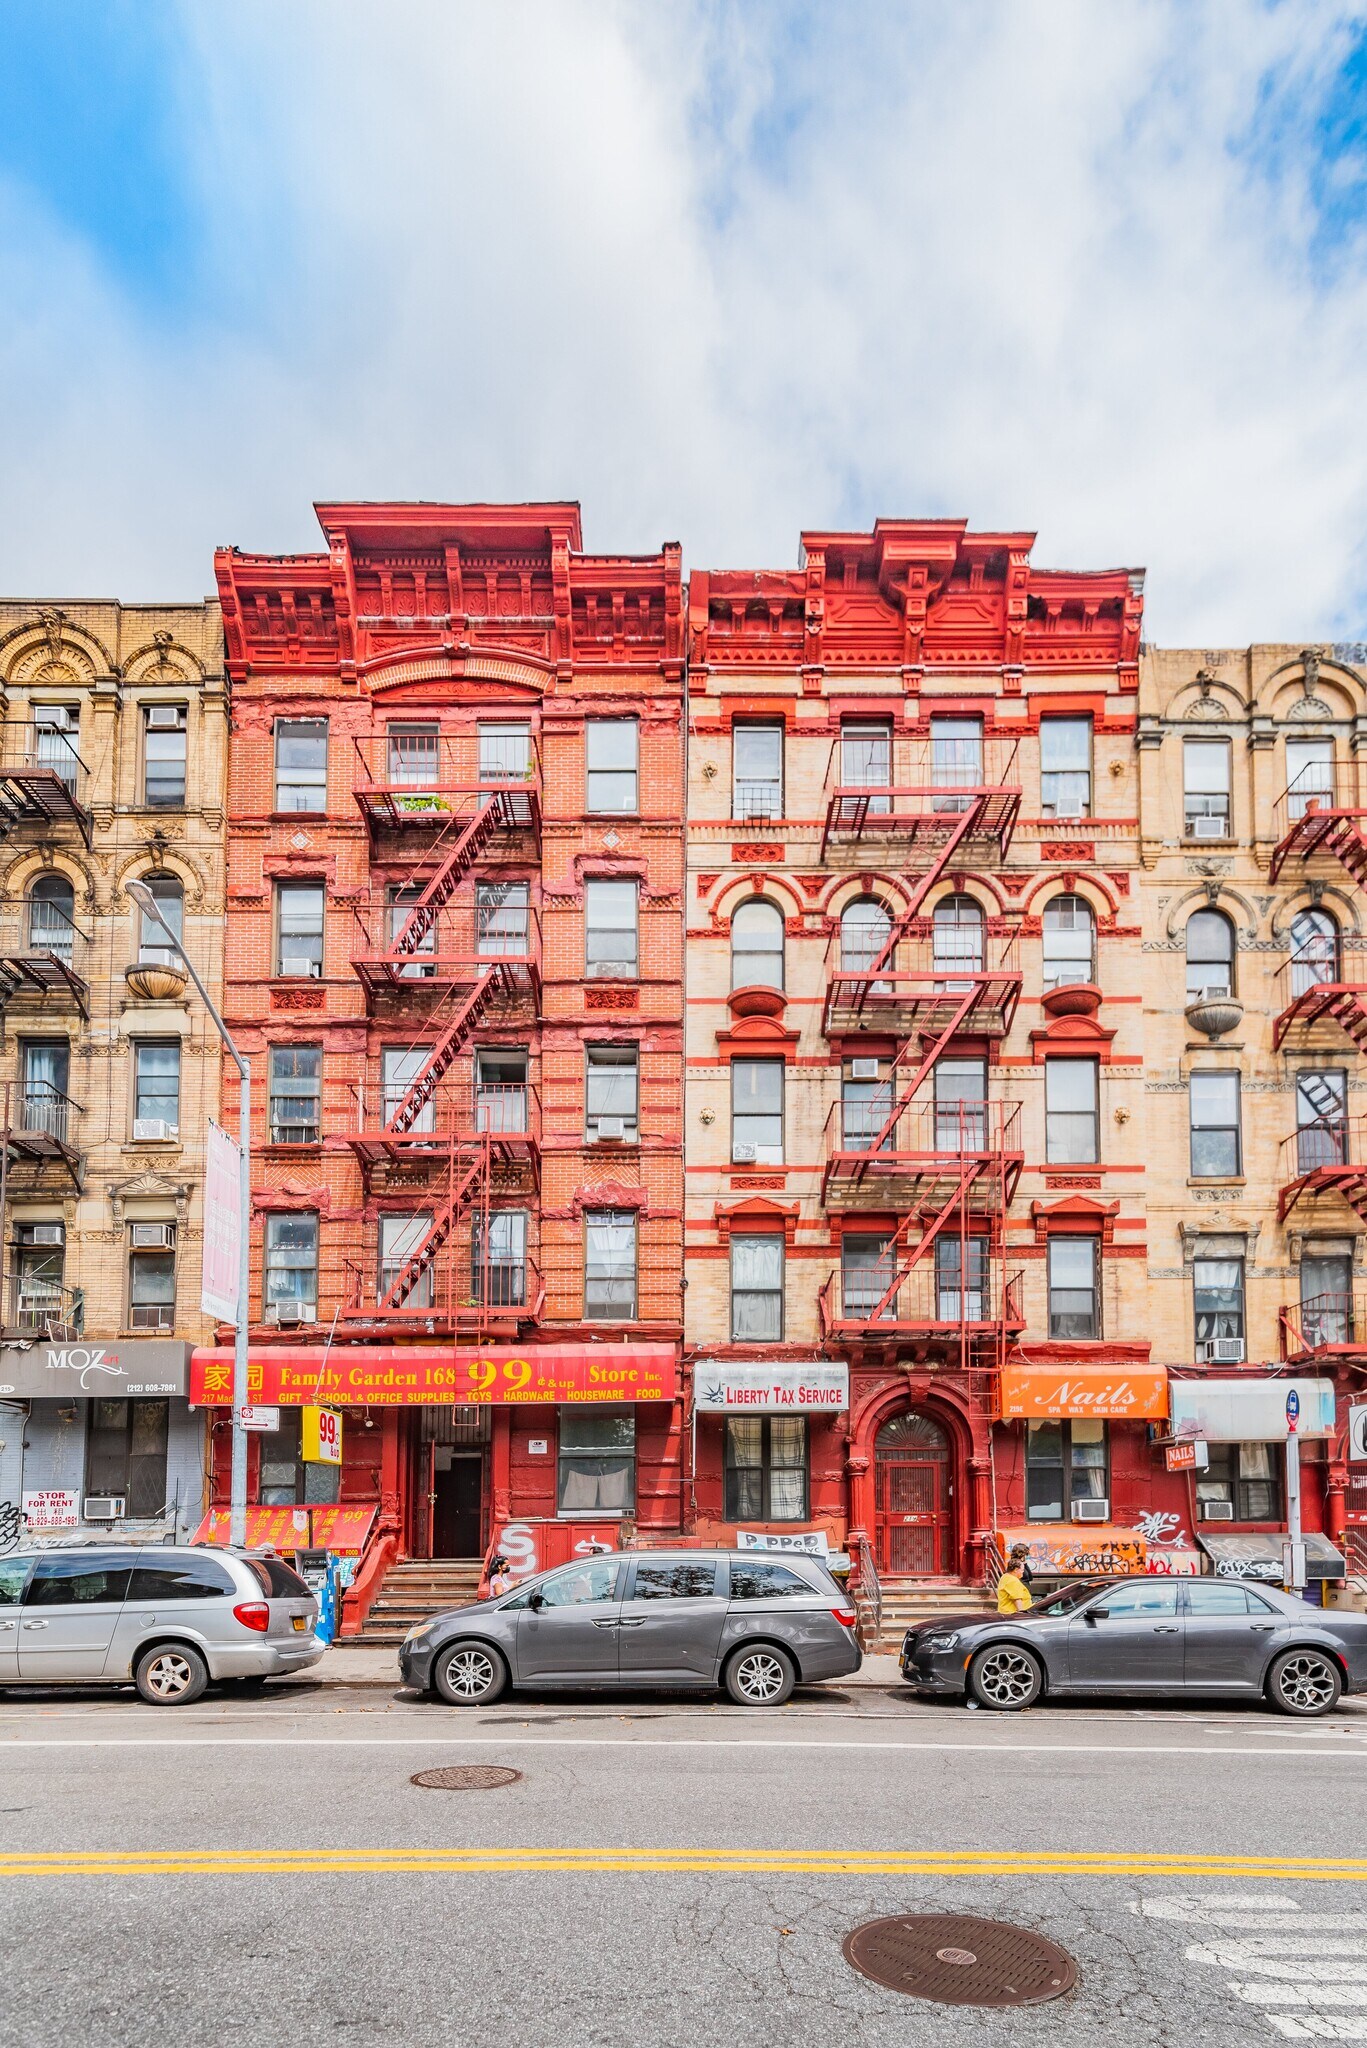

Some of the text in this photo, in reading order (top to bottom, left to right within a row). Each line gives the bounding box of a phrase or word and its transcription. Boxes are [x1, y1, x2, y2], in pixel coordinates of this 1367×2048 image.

[280, 1367, 456, 1390] Family Garden 168
[468, 1360, 532, 1391] 99
[589, 1365, 662, 1383] Store Inc.
[127, 1384, 143, 1392] (212)
[278, 1393, 302, 1402] GIFT
[367, 1393, 402, 1402] OFFICE
[407, 1392, 455, 1401] SUPPLIES
[467, 1391, 492, 1401] TOYS
[504, 1390, 555, 1400] HARDWARE
[567, 1388, 625, 1400] HOUSEWARE
[636, 1388, 662, 1398] FOOD
[726, 1387, 842, 1404] LIBERTY TAX SERVICE
[1034, 1381, 1138, 1405] Nails
[201, 1394, 213, 1402] 217
[252, 1394, 263, 1402] ST
[1169, 1445, 1194, 1462] NAILS
